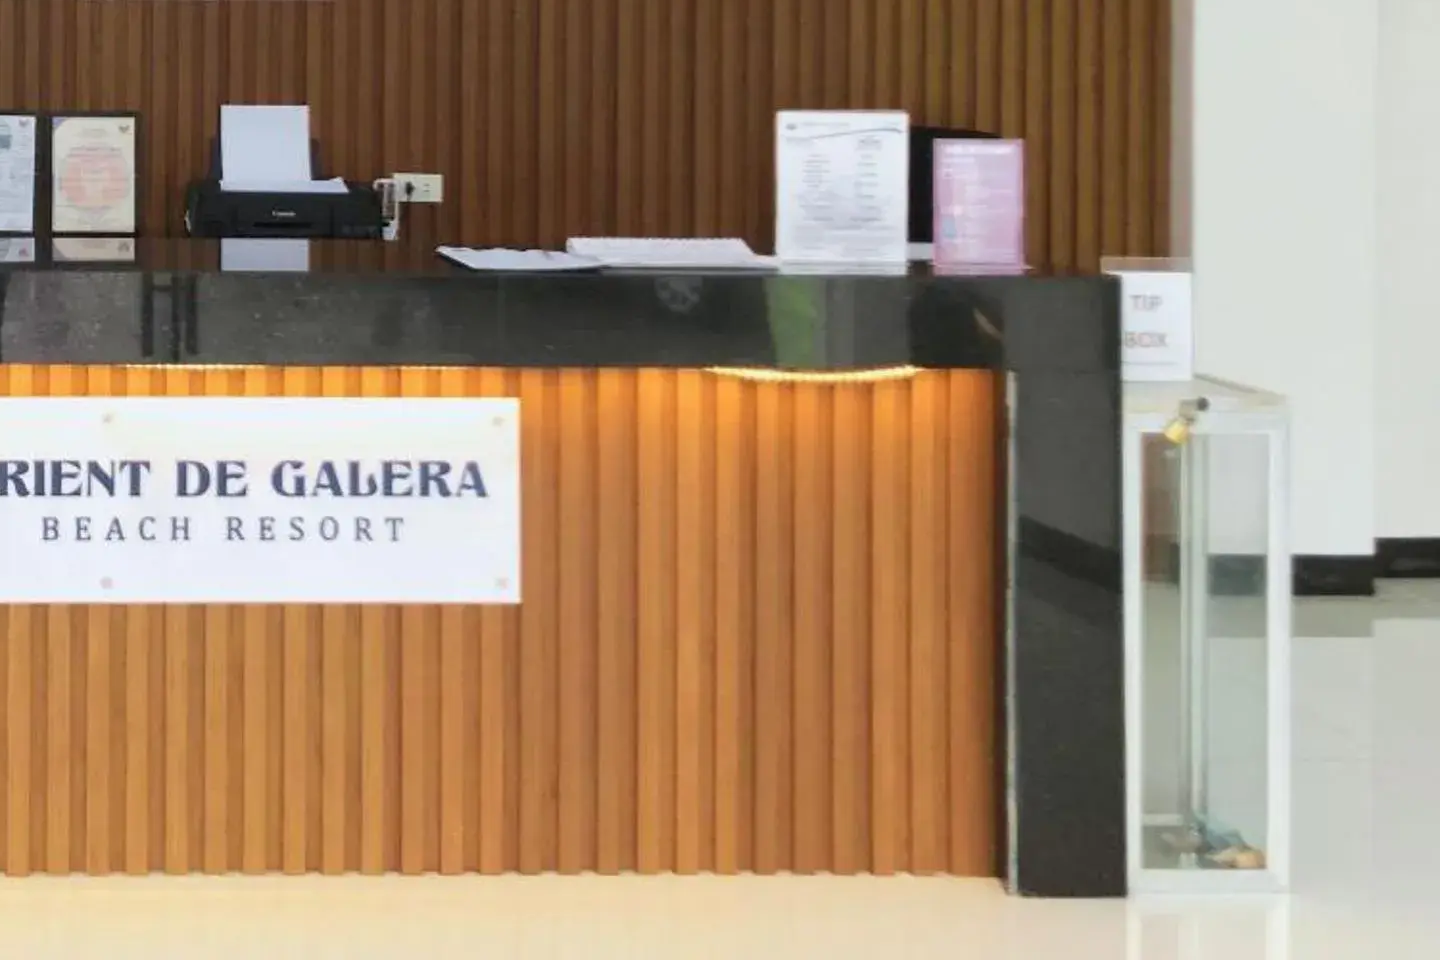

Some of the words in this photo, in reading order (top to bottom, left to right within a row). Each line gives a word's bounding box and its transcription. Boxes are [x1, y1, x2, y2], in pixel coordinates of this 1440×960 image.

[1129, 294, 1163, 311] TIP
[175, 460, 248, 497] DE
[271, 460, 490, 497] GALERA
[42, 516, 190, 541] BEACH
[225, 516, 404, 541] RESORT
